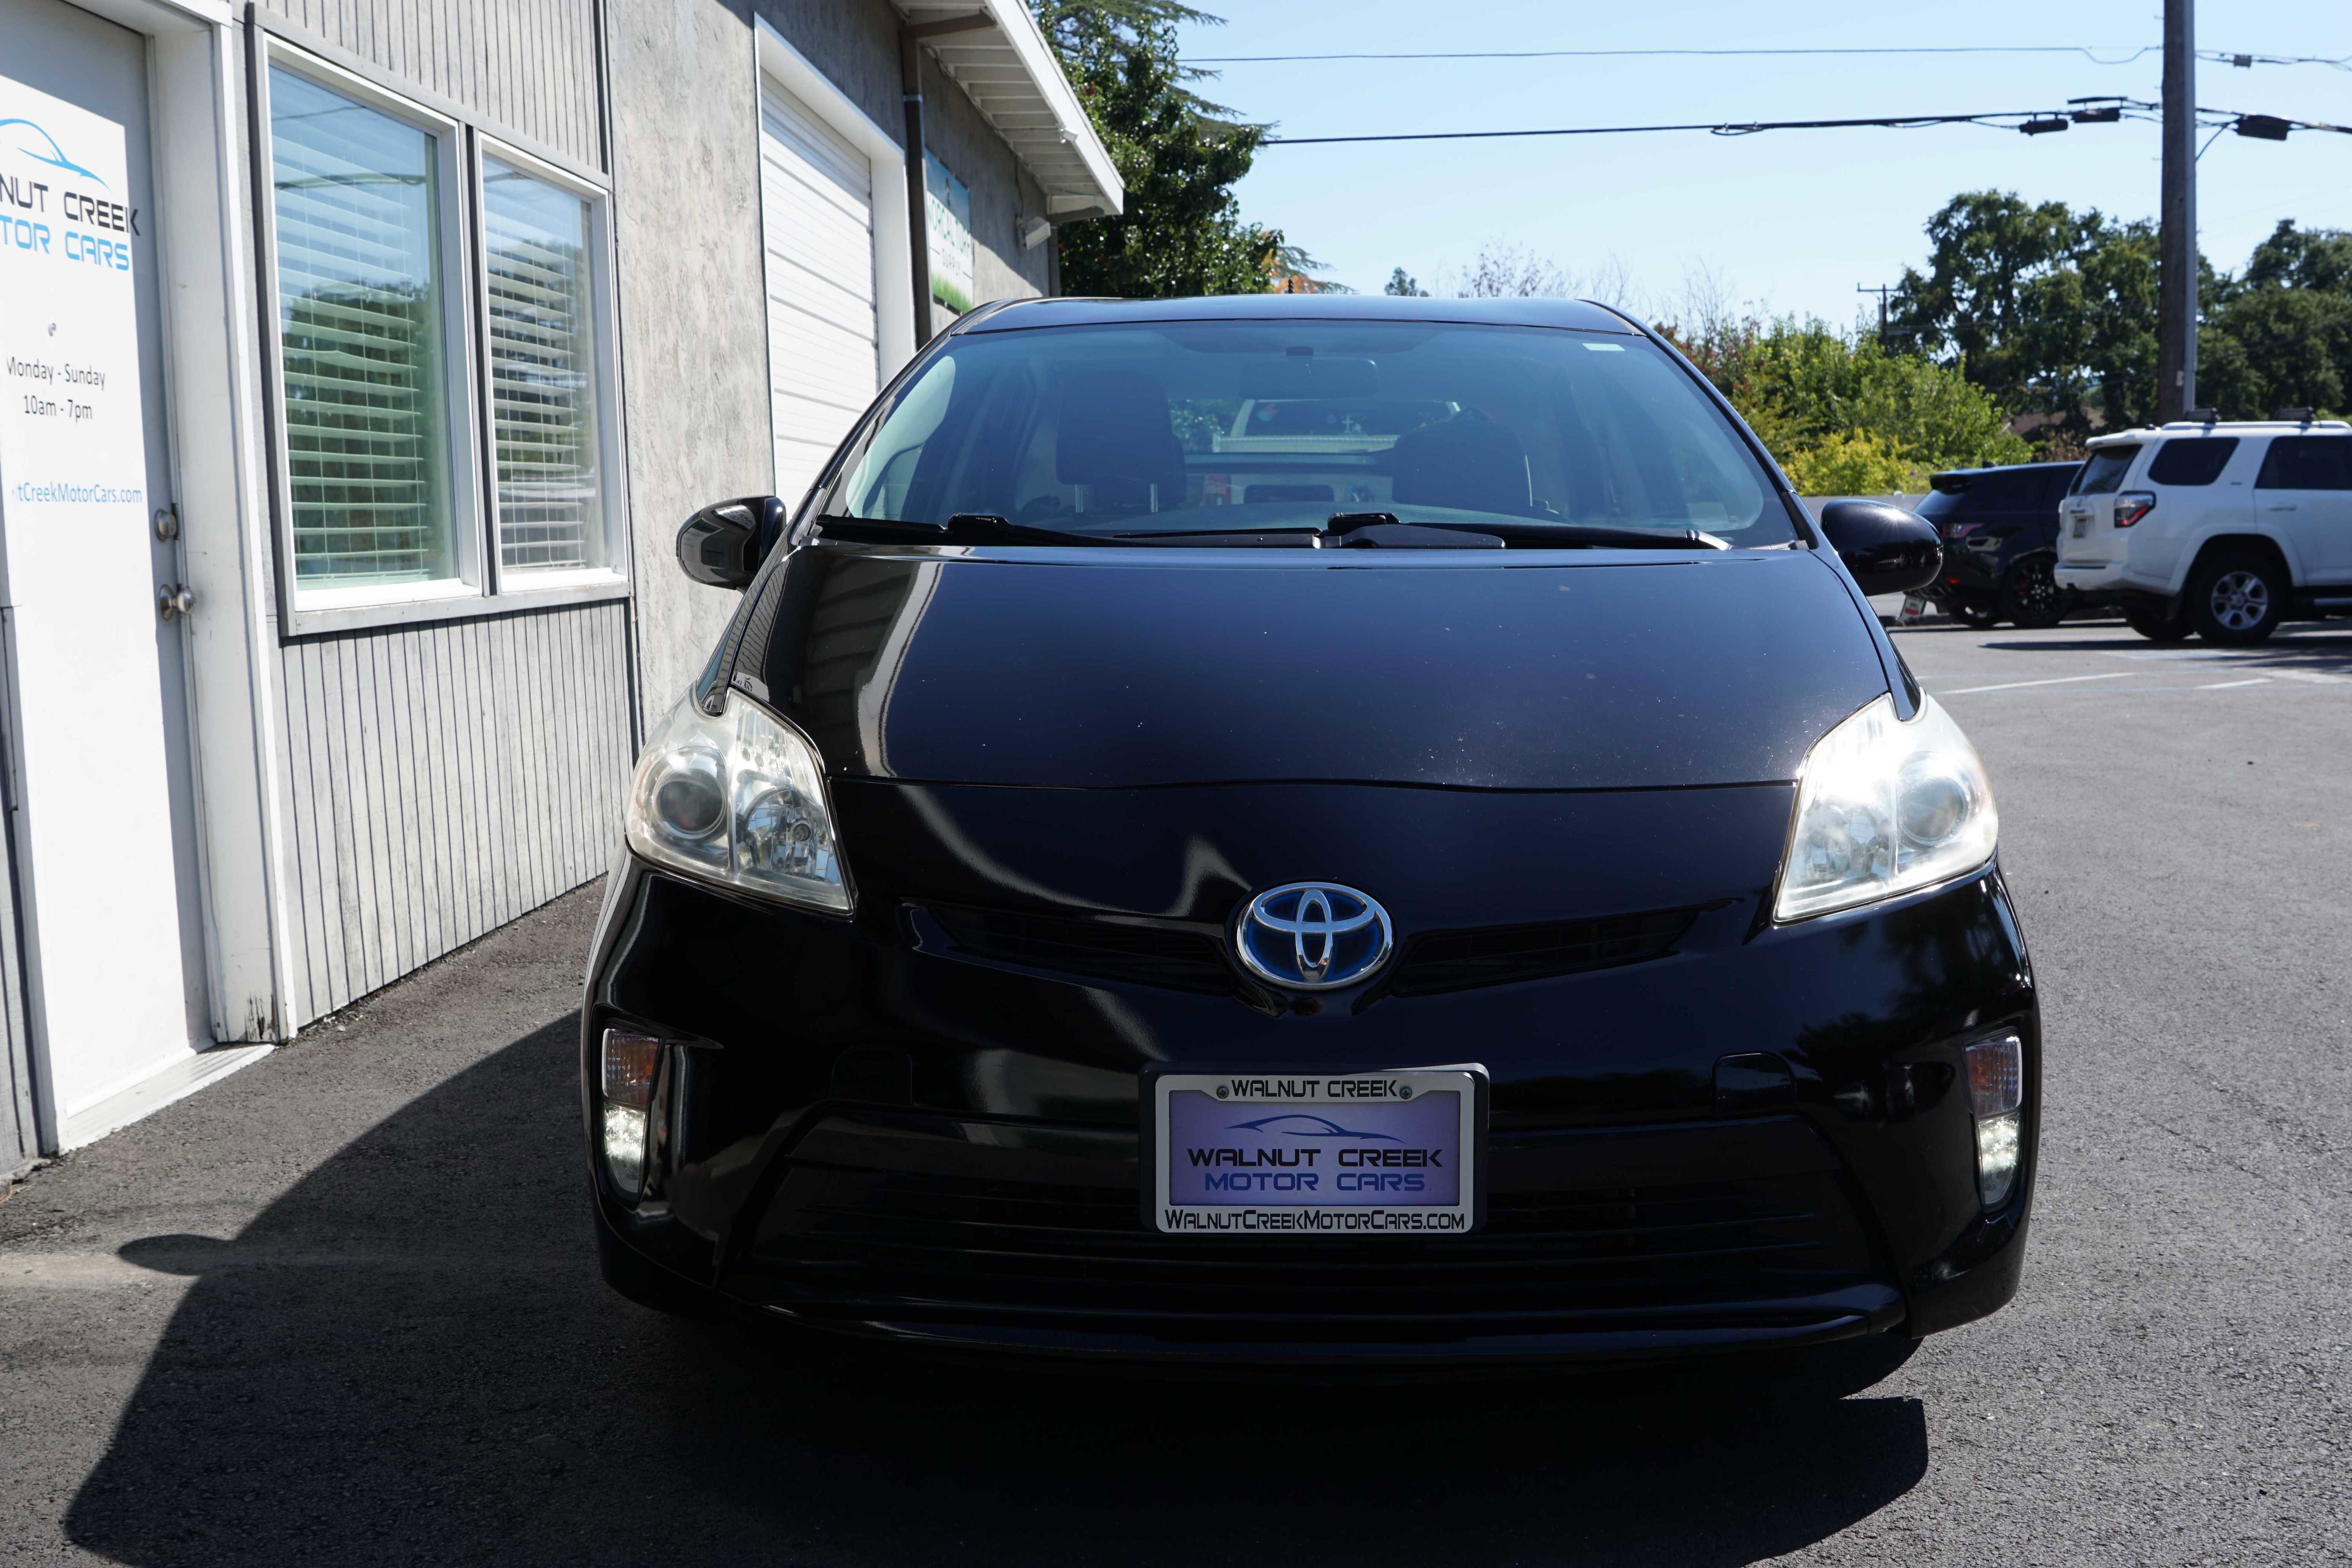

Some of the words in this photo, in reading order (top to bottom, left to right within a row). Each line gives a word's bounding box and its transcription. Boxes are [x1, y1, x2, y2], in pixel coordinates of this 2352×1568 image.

[64, 191, 140, 236] CREEK
[0, 214, 50, 254] TOR
[65, 231, 129, 271] CARS
[7, 356, 53, 385] Monday
[65, 363, 105, 390] Sunday
[23, 394, 56, 416] 10am
[67, 399, 92, 423] 7pm
[16, 481, 142, 503] tCreekMotorCars.com
[1232, 1080, 1319, 1097] WALNUT
[1327, 1080, 1397, 1097] CREEK
[1187, 1149, 1321, 1166] WALNUT
[1339, 1149, 1443, 1167] CREEK
[1205, 1173, 1319, 1190] MOTOR
[1336, 1173, 1424, 1191] CARS
